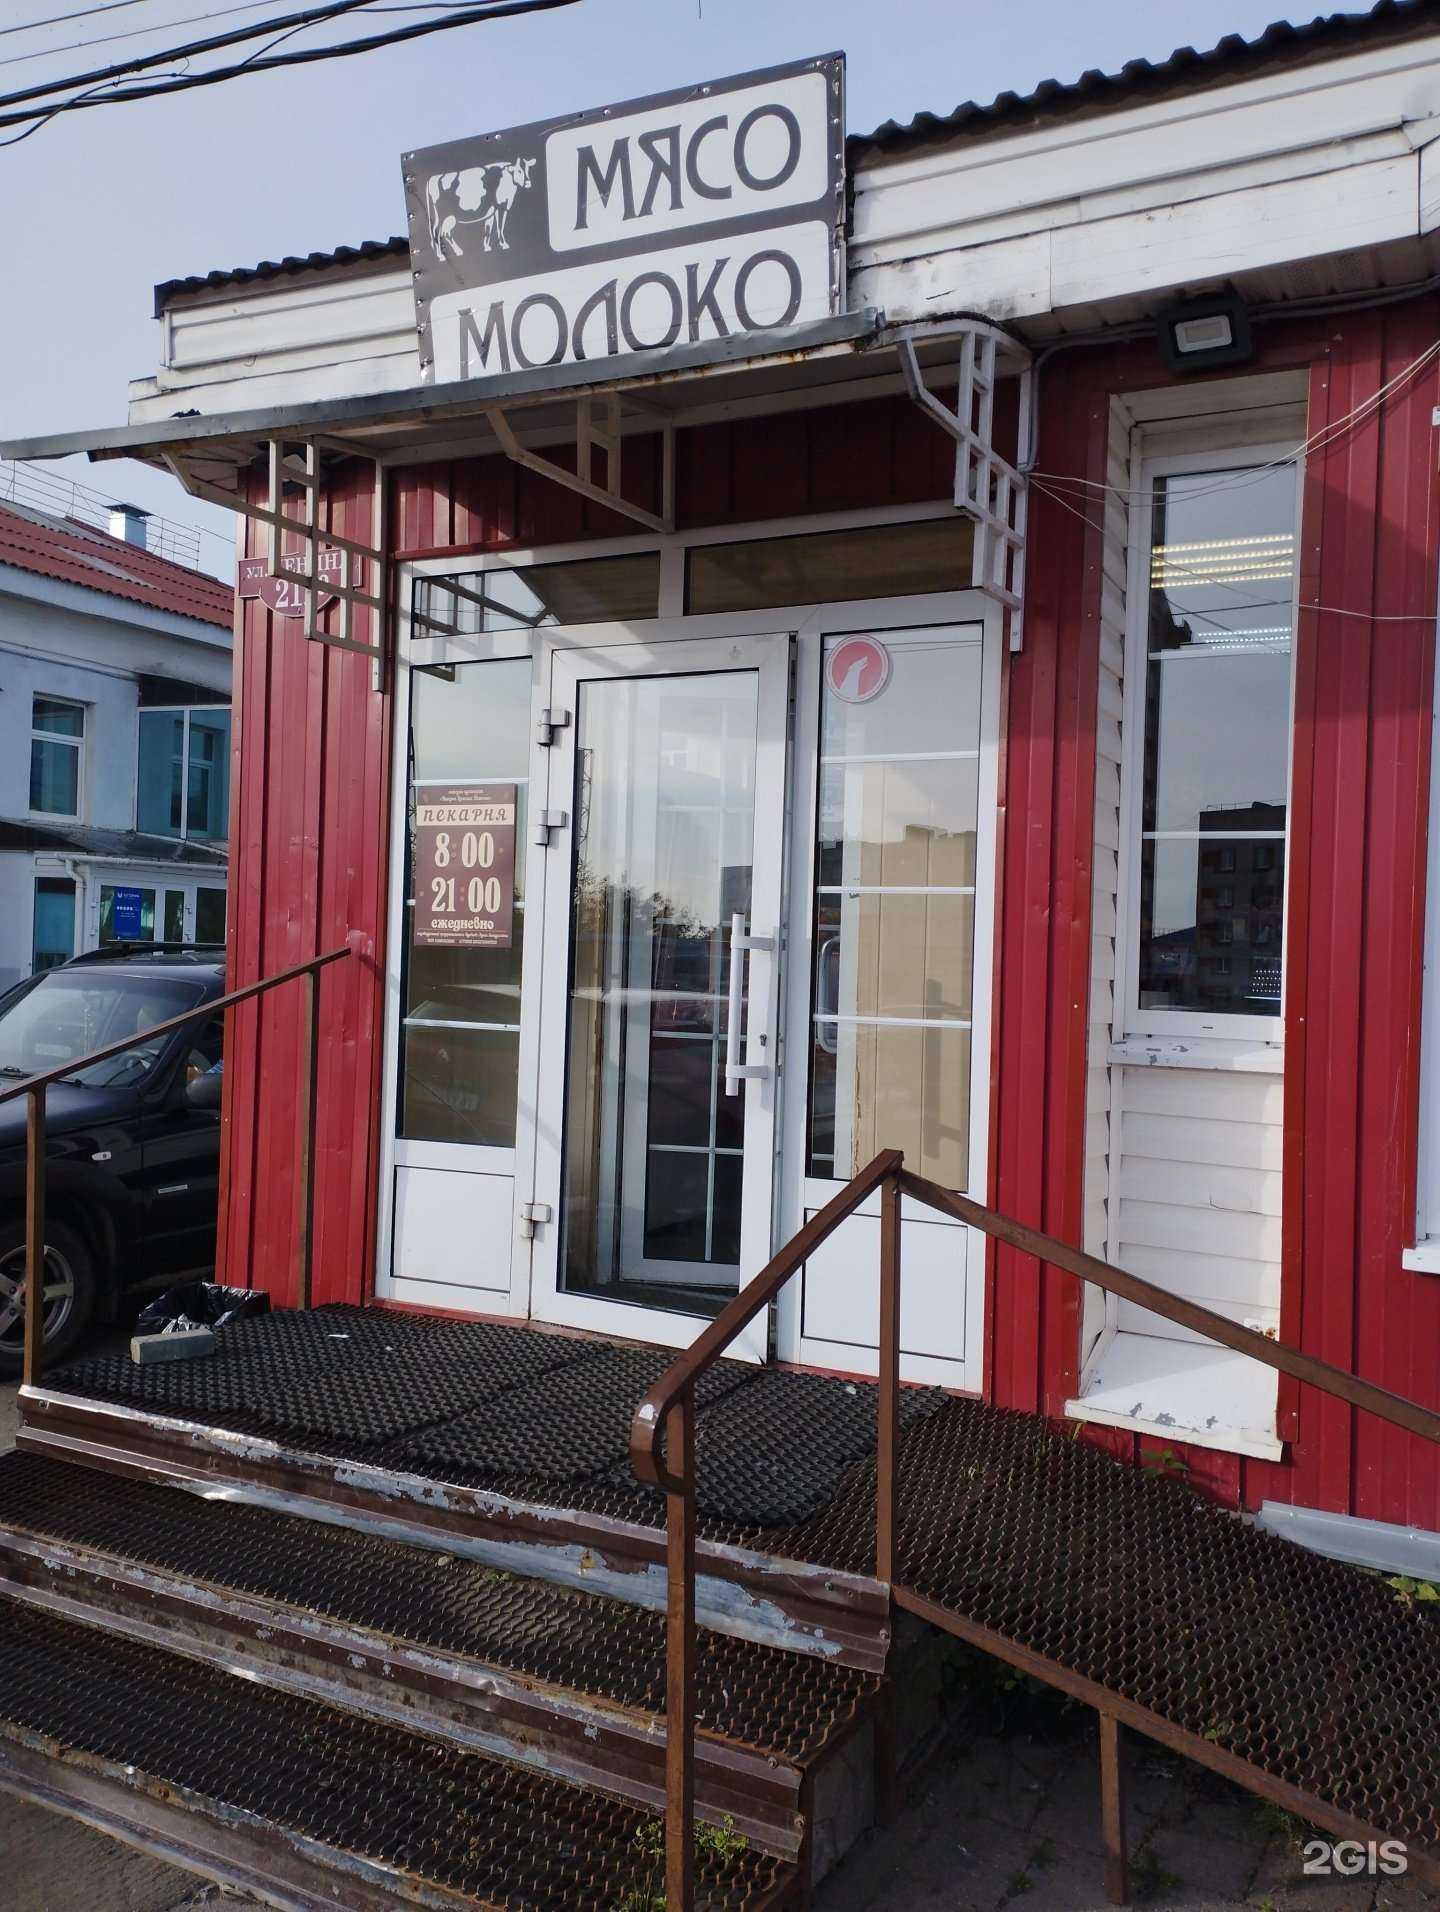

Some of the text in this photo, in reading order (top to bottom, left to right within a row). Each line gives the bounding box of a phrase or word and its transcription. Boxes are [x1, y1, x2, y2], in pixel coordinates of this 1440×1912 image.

[573, 103, 801, 231] МЯСО
[457, 248, 803, 380] МОЛОКО
[431, 916, 495, 932] ежедневно
